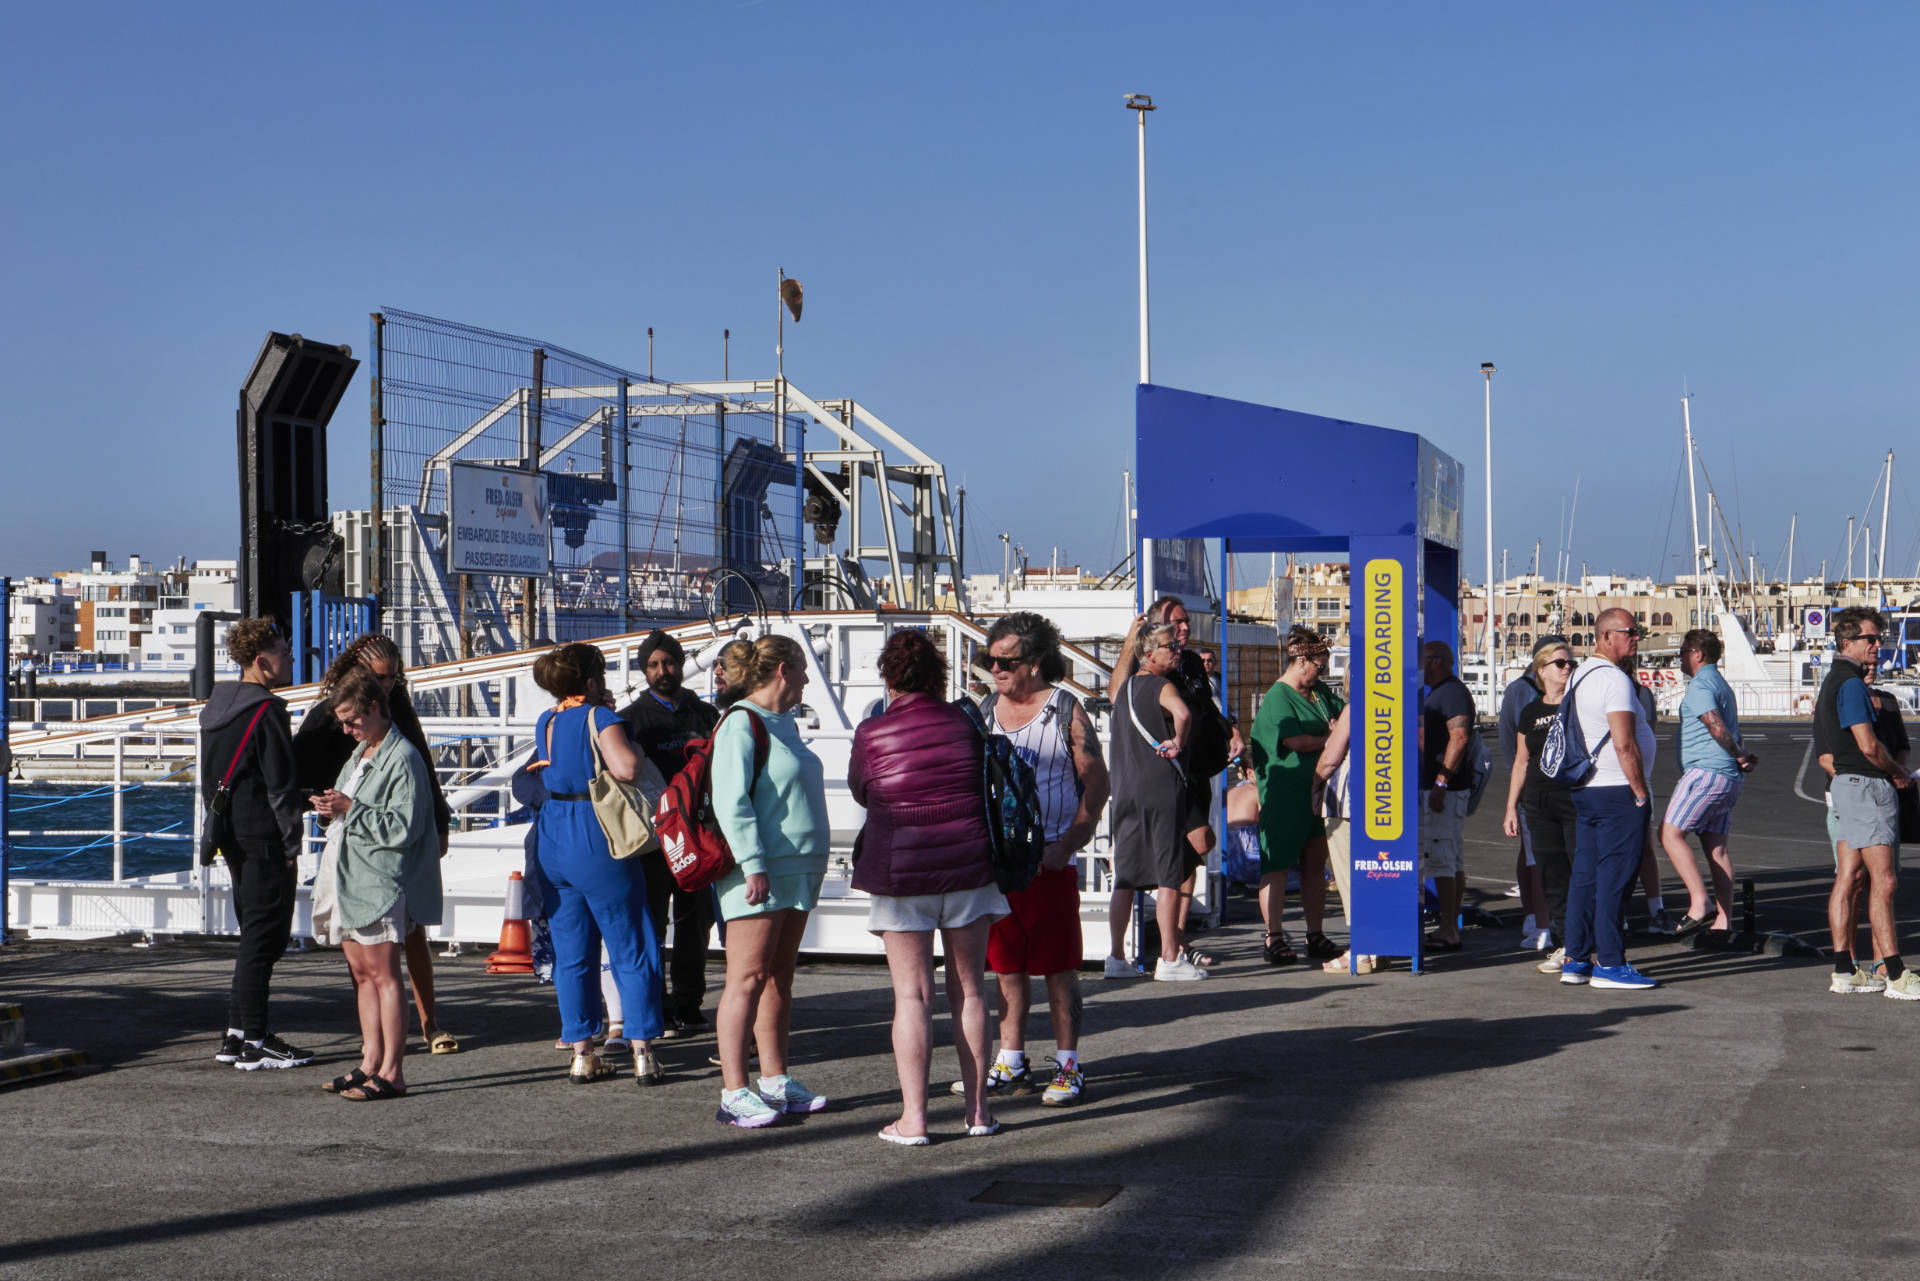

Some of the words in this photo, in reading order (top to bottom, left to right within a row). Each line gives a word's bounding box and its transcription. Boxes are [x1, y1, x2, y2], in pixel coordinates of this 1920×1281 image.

[505, 490, 523, 508] OLSEN
[457, 526, 500, 543] EMBARQUE
[501, 530, 510, 544] DE
[510, 531, 545, 547] PASAJEROS
[464, 551, 509, 567] PASSENGER
[510, 554, 541, 569] BOARDING
[1375, 572, 1392, 684] BOARDING
[1373, 690, 1395, 701] /
[1375, 707, 1393, 827] EMBARQUE
